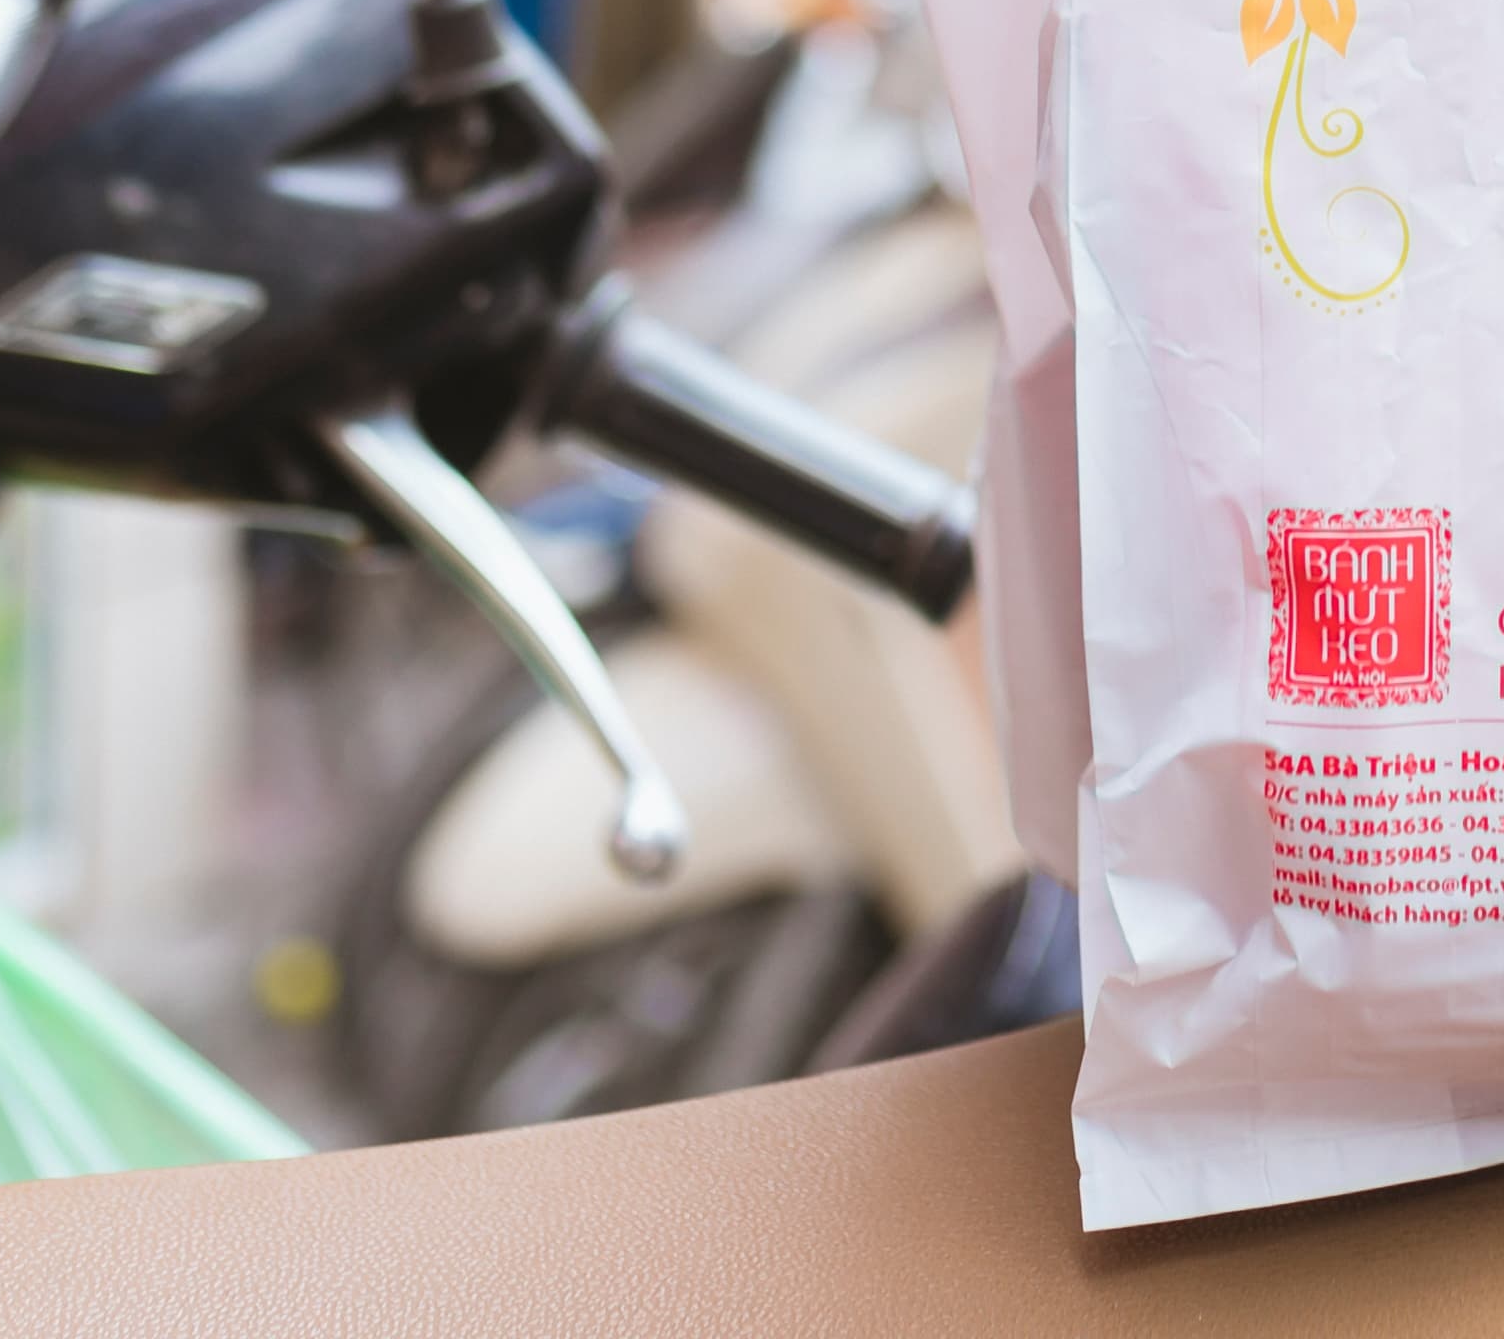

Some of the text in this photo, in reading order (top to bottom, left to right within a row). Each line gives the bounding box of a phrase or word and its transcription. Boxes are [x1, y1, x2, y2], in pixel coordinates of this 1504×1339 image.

[1323, 756, 1358, 778] Bà
[1366, 753, 1436, 782] Triệu
[1305, 788, 1347, 807] nhà
[1353, 790, 1399, 812] máy
[1300, 815, 1444, 837] 04.33843636
[1273, 840, 1303, 859] ax:
[1308, 844, 1451, 866] 04.38359845
[1273, 868, 1326, 887] mail:
[1335, 899, 1398, 923] khách
[1405, 904, 1467, 927] hàng:
